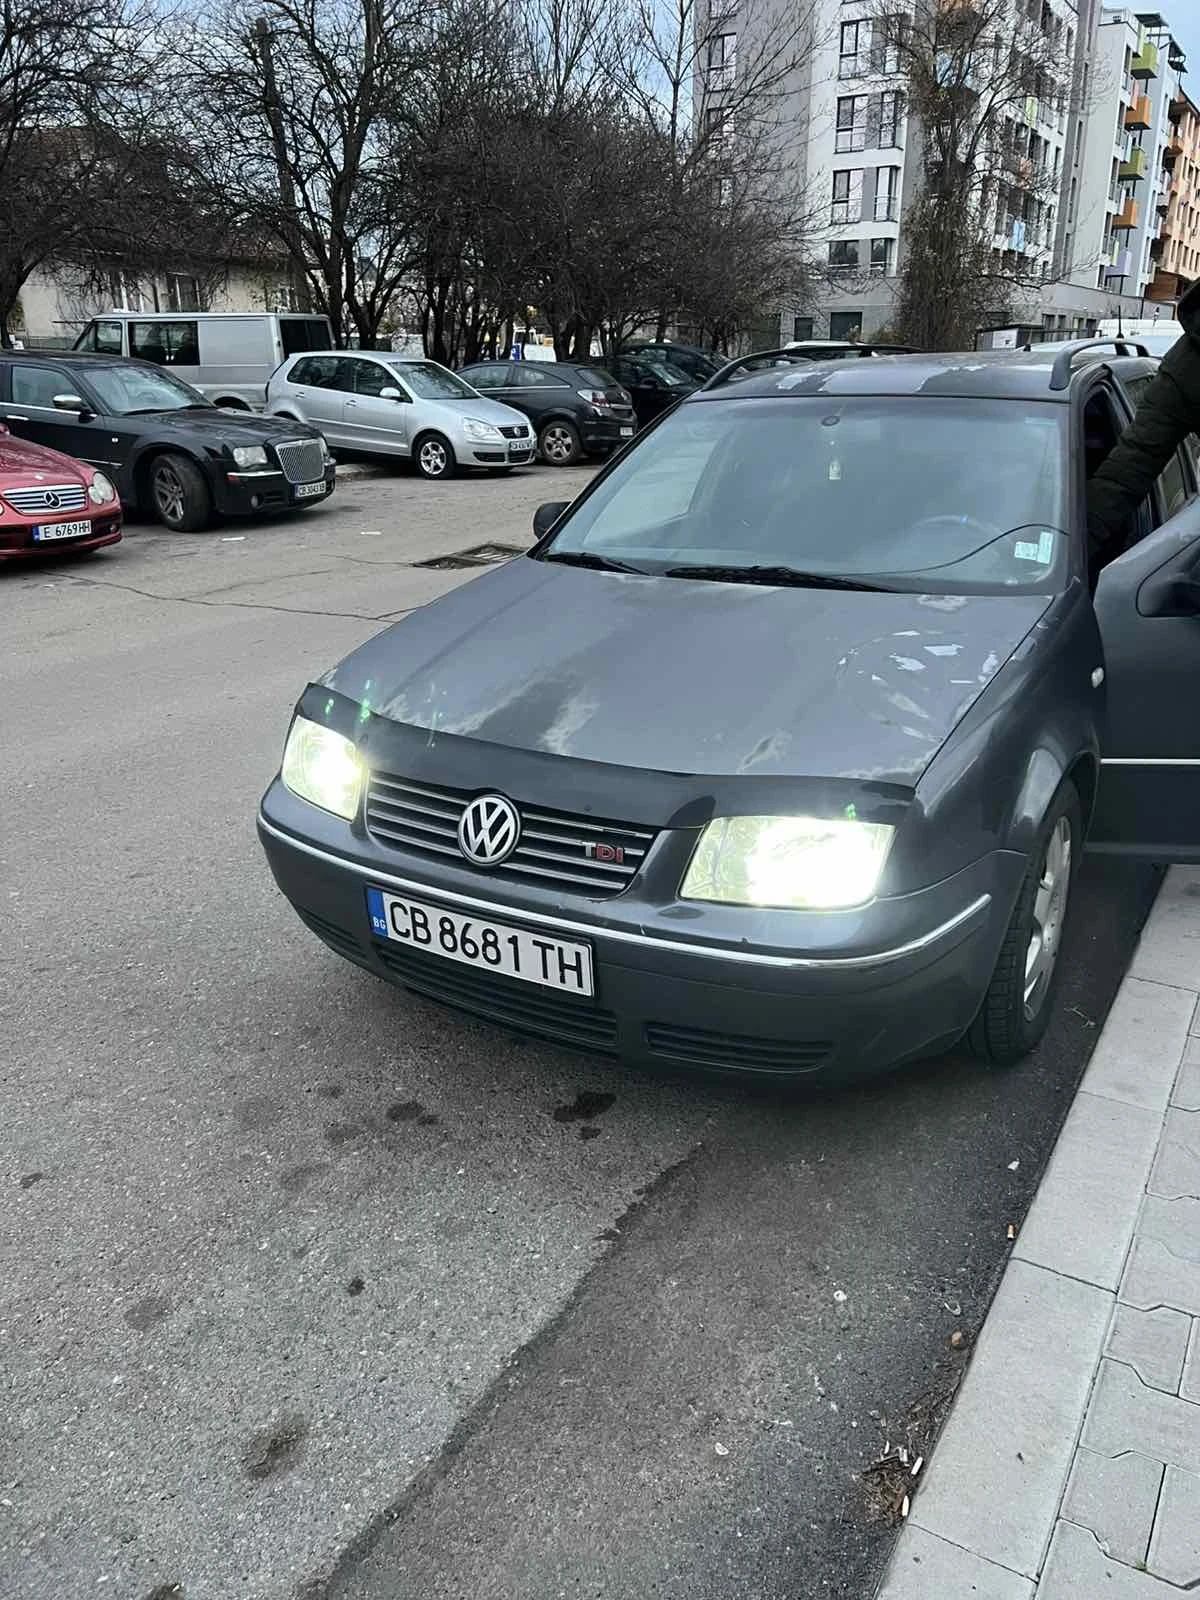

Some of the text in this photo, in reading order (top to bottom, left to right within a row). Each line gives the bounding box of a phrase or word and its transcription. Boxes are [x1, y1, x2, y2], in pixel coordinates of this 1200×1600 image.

[43, 526, 51, 539] E
[55, 523, 78, 537] 6769
[462, 797, 515, 862] VW
[582, 841, 624, 865] TDI
[373, 916, 387, 930] BG
[390, 901, 584, 989] CB 8681 TH
